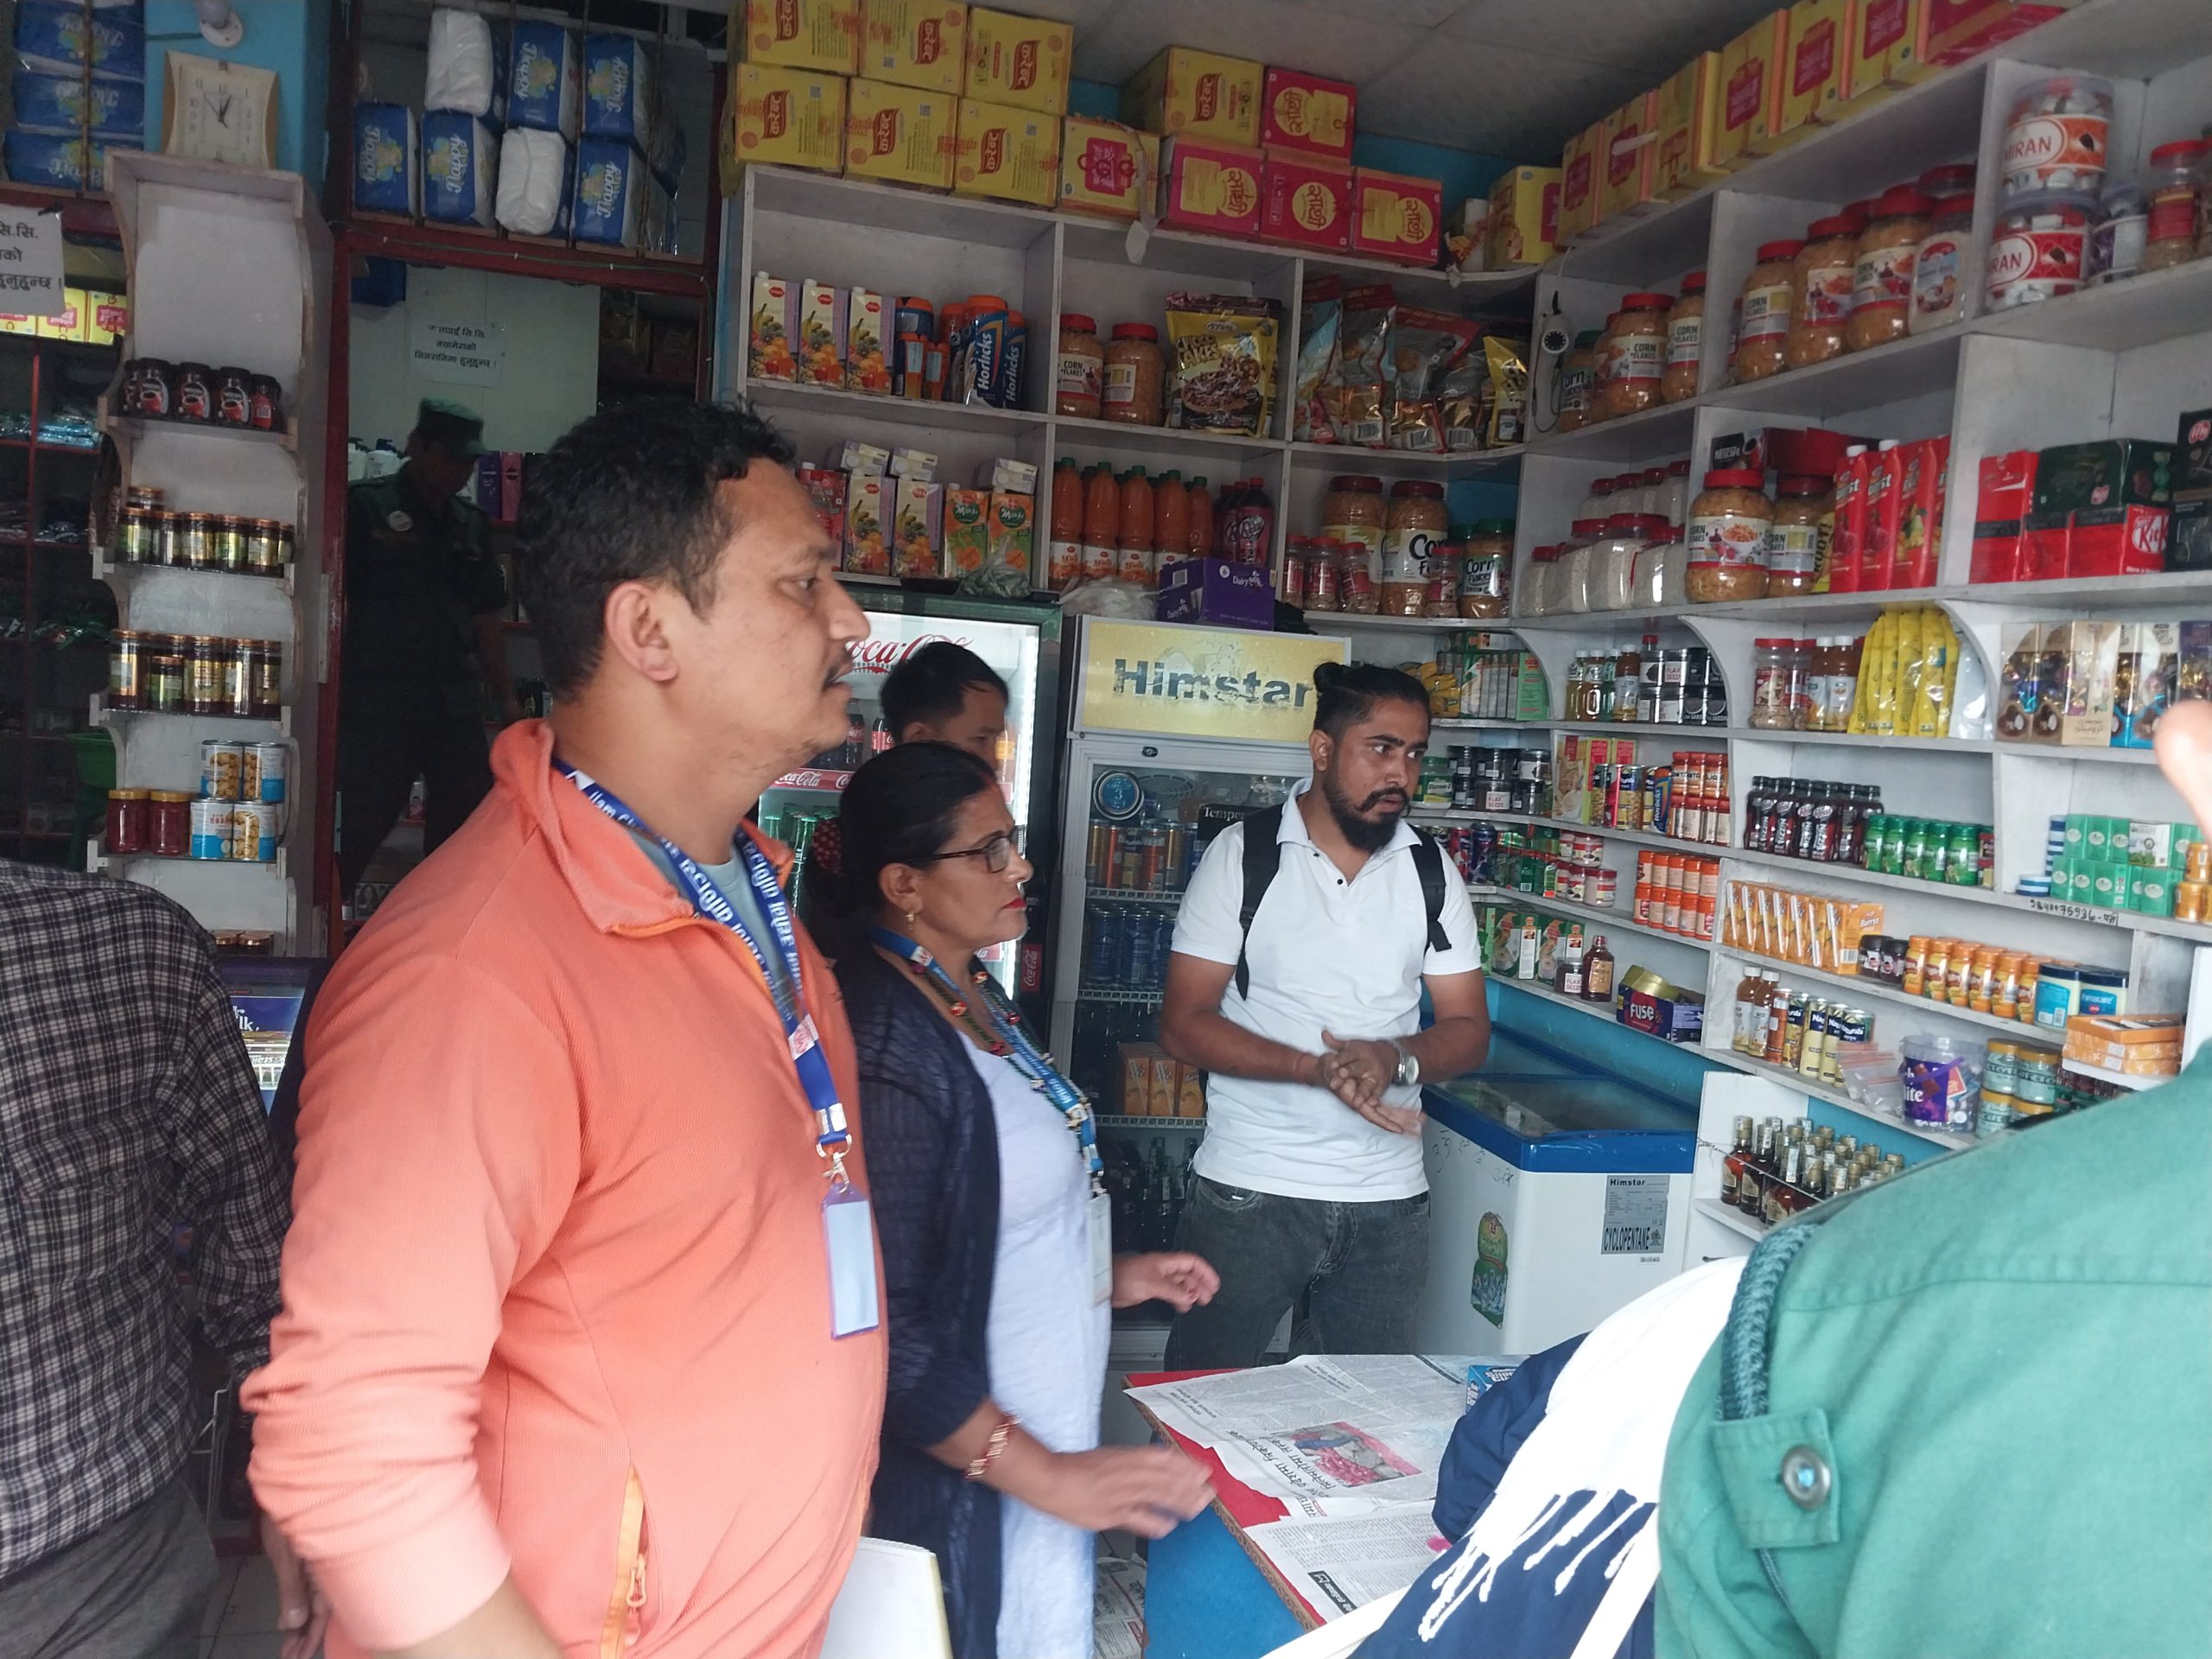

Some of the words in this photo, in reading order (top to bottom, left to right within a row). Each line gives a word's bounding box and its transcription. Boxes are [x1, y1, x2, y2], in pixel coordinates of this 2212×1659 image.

[1634, 342, 1657, 353] CORN
[977, 332, 993, 391] Horlicks
[1005, 345, 1020, 403] Horlicks
[1063, 359, 1084, 370] CORN
[1562, 371, 1586, 387] orn
[1409, 533, 1449, 560] Cor
[1232, 575, 1249, 587] Dairy
[1113, 658, 1314, 709] Himstar
[1024, 945, 1039, 988] Coca-Cola
[1610, 1178, 1646, 1187] Himstar
[1603, 1226, 1651, 1252] CYCLOPENTANE
